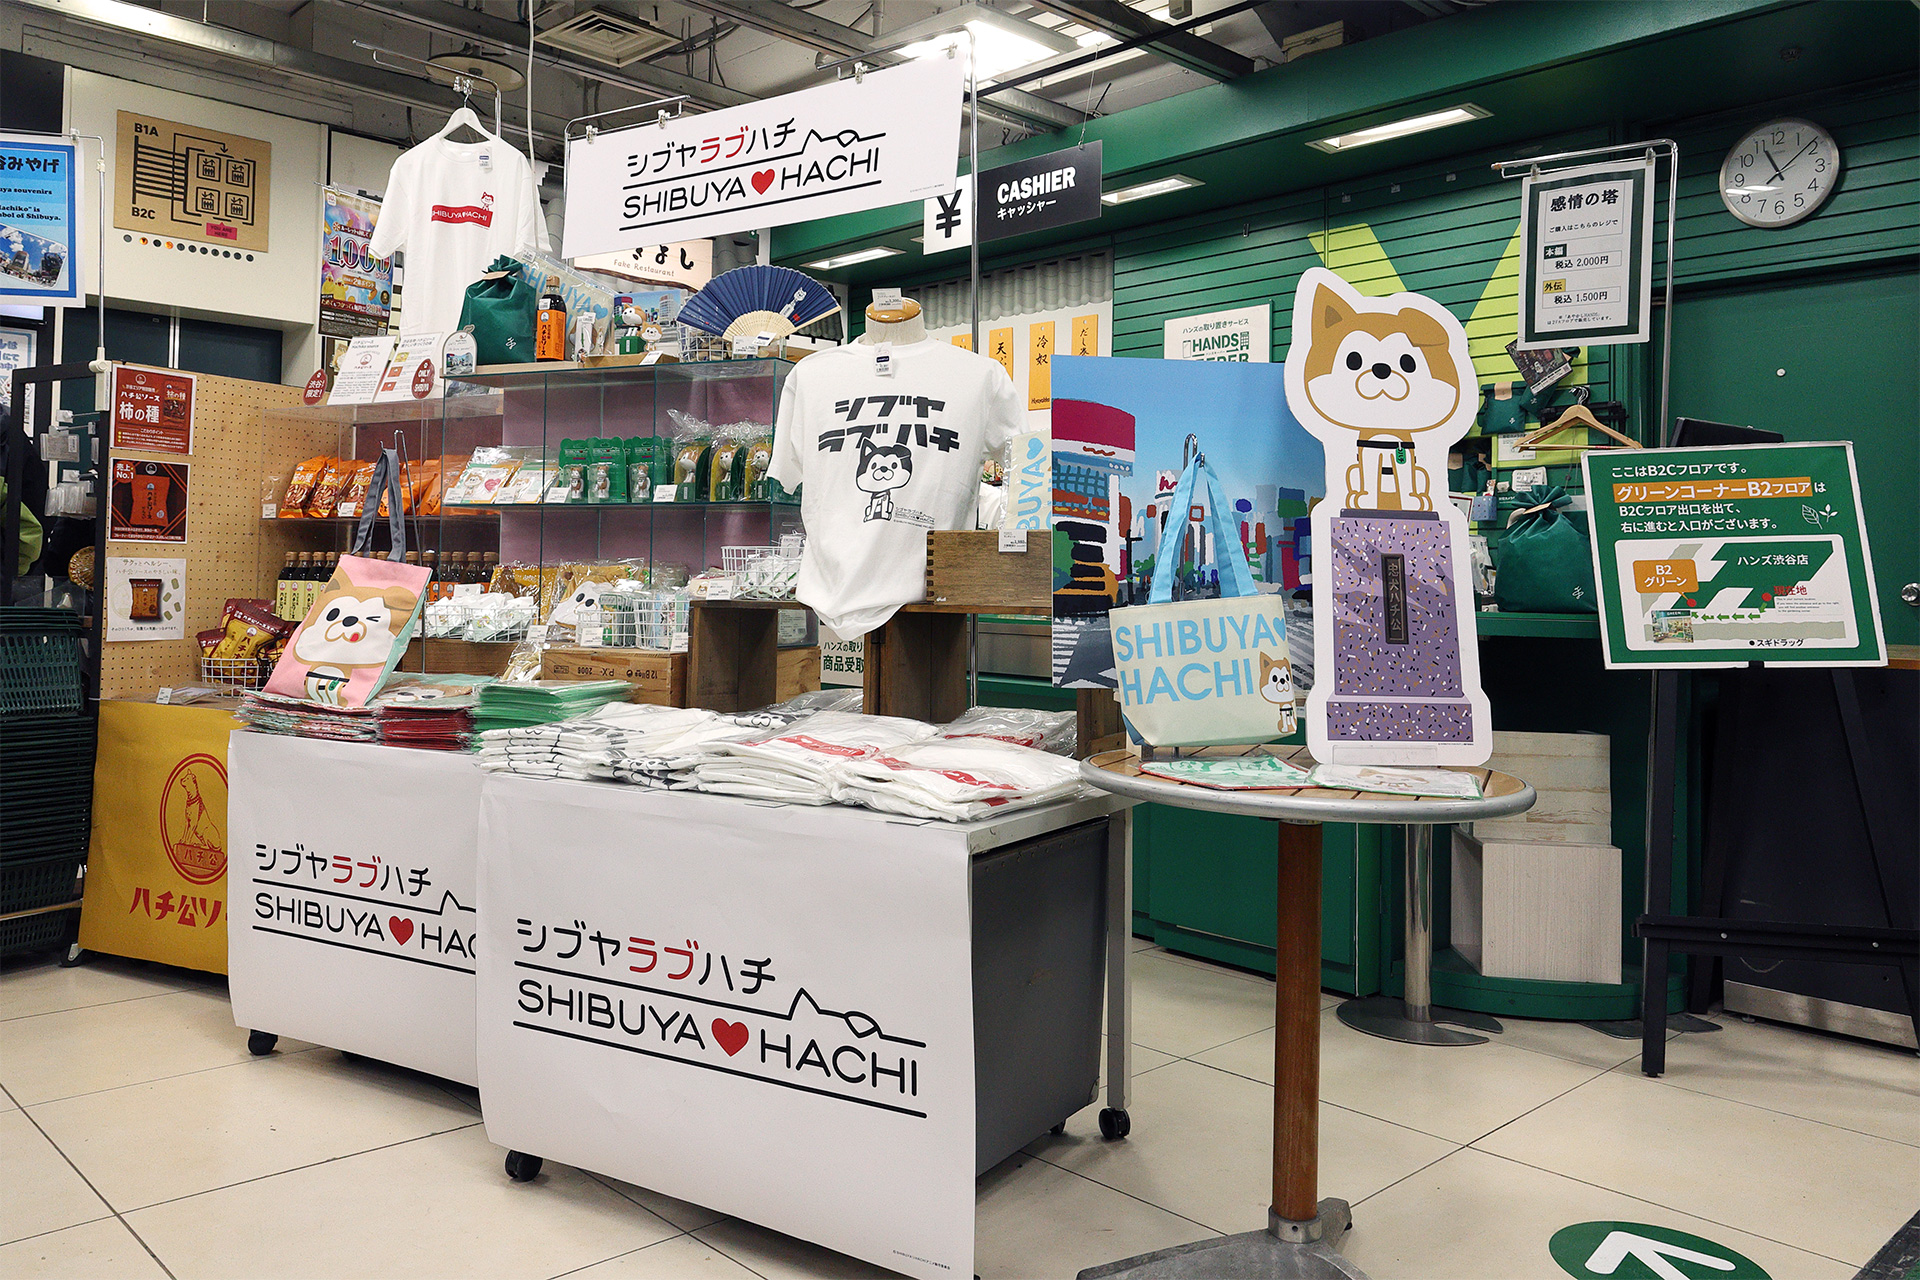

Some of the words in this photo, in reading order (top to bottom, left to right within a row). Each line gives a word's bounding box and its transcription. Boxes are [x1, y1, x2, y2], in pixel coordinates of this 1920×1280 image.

[134, 122, 159, 137] B1A
[1771, 130, 1785, 146] 12
[1796, 132, 1800, 146] 1
[627, 117, 796, 178] シブヤラブハチ
[1808, 140, 1818, 156] 2
[1740, 153, 1754, 168] 10
[1814, 158, 1826, 173] 3
[623, 176, 746, 219] SHIBUYA
[781, 147, 880, 190] HACHI
[997, 165, 1076, 205] CASHIER
[1734, 173, 1745, 188] 9
[1807, 177, 1819, 192] 4
[1550, 188, 1619, 212] 感情の塔
[1757, 199, 1767, 214] 7
[1774, 200, 1785, 215] 6
[1793, 193, 1805, 208] 5
[131, 206, 156, 220] B2C
[997, 199, 1057, 221] キャッシャー
[1549, 219, 1619, 234] ご購入はこちらのレジで
[613, 258, 631, 270] Fake
[634, 262, 675, 277] Restaurant
[1555, 259, 1573, 270] 税込
[1544, 281, 1563, 292] 外伝
[1554, 295, 1572, 305] 税込
[1182, 318, 1249, 334] ハンズの取り置きサービス
[1192, 333, 1240, 353] HANDS
[308, 379, 325, 390] 渋谷!
[120, 391, 160, 402] ハチ公ソース
[305, 389, 323, 399] 限定!
[119, 401, 160, 424] 柿の種
[835, 395, 946, 422] シブヤ
[818, 423, 961, 453] ラブハチ
[116, 463, 131, 471] 売上
[1611, 461, 1747, 478] ここはB2Cフロアです。
[116, 471, 134, 480] No.1
[1619, 502, 1741, 517] B2Cフロア出口を出て、
[1621, 517, 1777, 534] 右に進むと入口がございます。
[1737, 554, 1809, 566] ハンズ渋谷店
[1656, 564, 1673, 575] B2
[1644, 576, 1687, 588] グリーン
[1387, 562, 1402, 631] 忠犬ハチ公
[1773, 585, 1807, 596] 現在地
[1115, 613, 1278, 662] SHIBUYA
[1757, 638, 1804, 647] スギドラッグ
[823, 655, 864, 673] 商品受取
[1120, 657, 1254, 706] HACHI
[184, 848, 218, 866] ハチ公
[255, 842, 431, 896] シブヤラブハチ
[129, 887, 228, 928] ハチ公ソ
[255, 892, 385, 942] SHIBUYA
[517, 918, 776, 994] シブヤラブハチ
[518, 980, 706, 1050] SHIBUYA
[760, 1028, 918, 1097] HACHI
